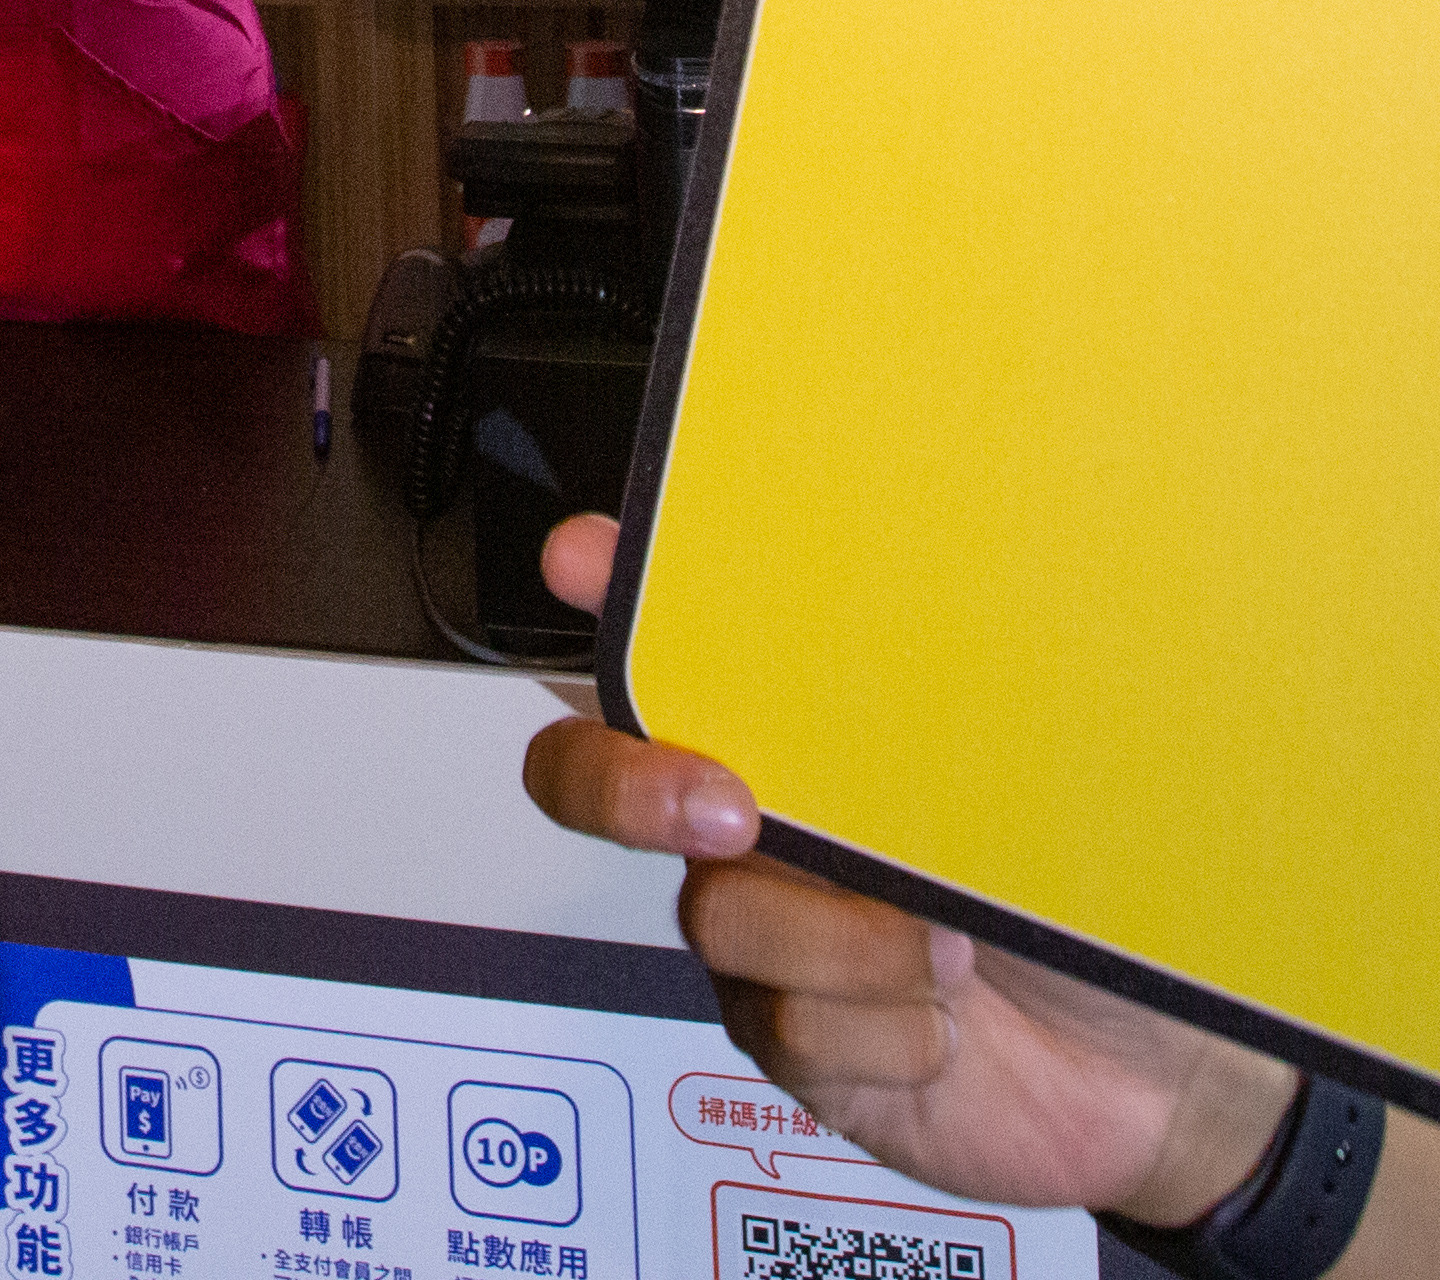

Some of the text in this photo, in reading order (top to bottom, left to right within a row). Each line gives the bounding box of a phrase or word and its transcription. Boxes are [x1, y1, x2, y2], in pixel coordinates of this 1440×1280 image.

[130, 1085, 162, 1108] Pay
[10, 1032, 65, 1277] 更多功能
[476, 1137, 517, 1169] 10
[126, 1181, 201, 1225] 付款
[124, 1224, 201, 1252] 銀行帳戶
[298, 1207, 375, 1251] 轉帳
[124, 1251, 183, 1276] 信用卡
[446, 1229, 590, 1280] 點數應用
